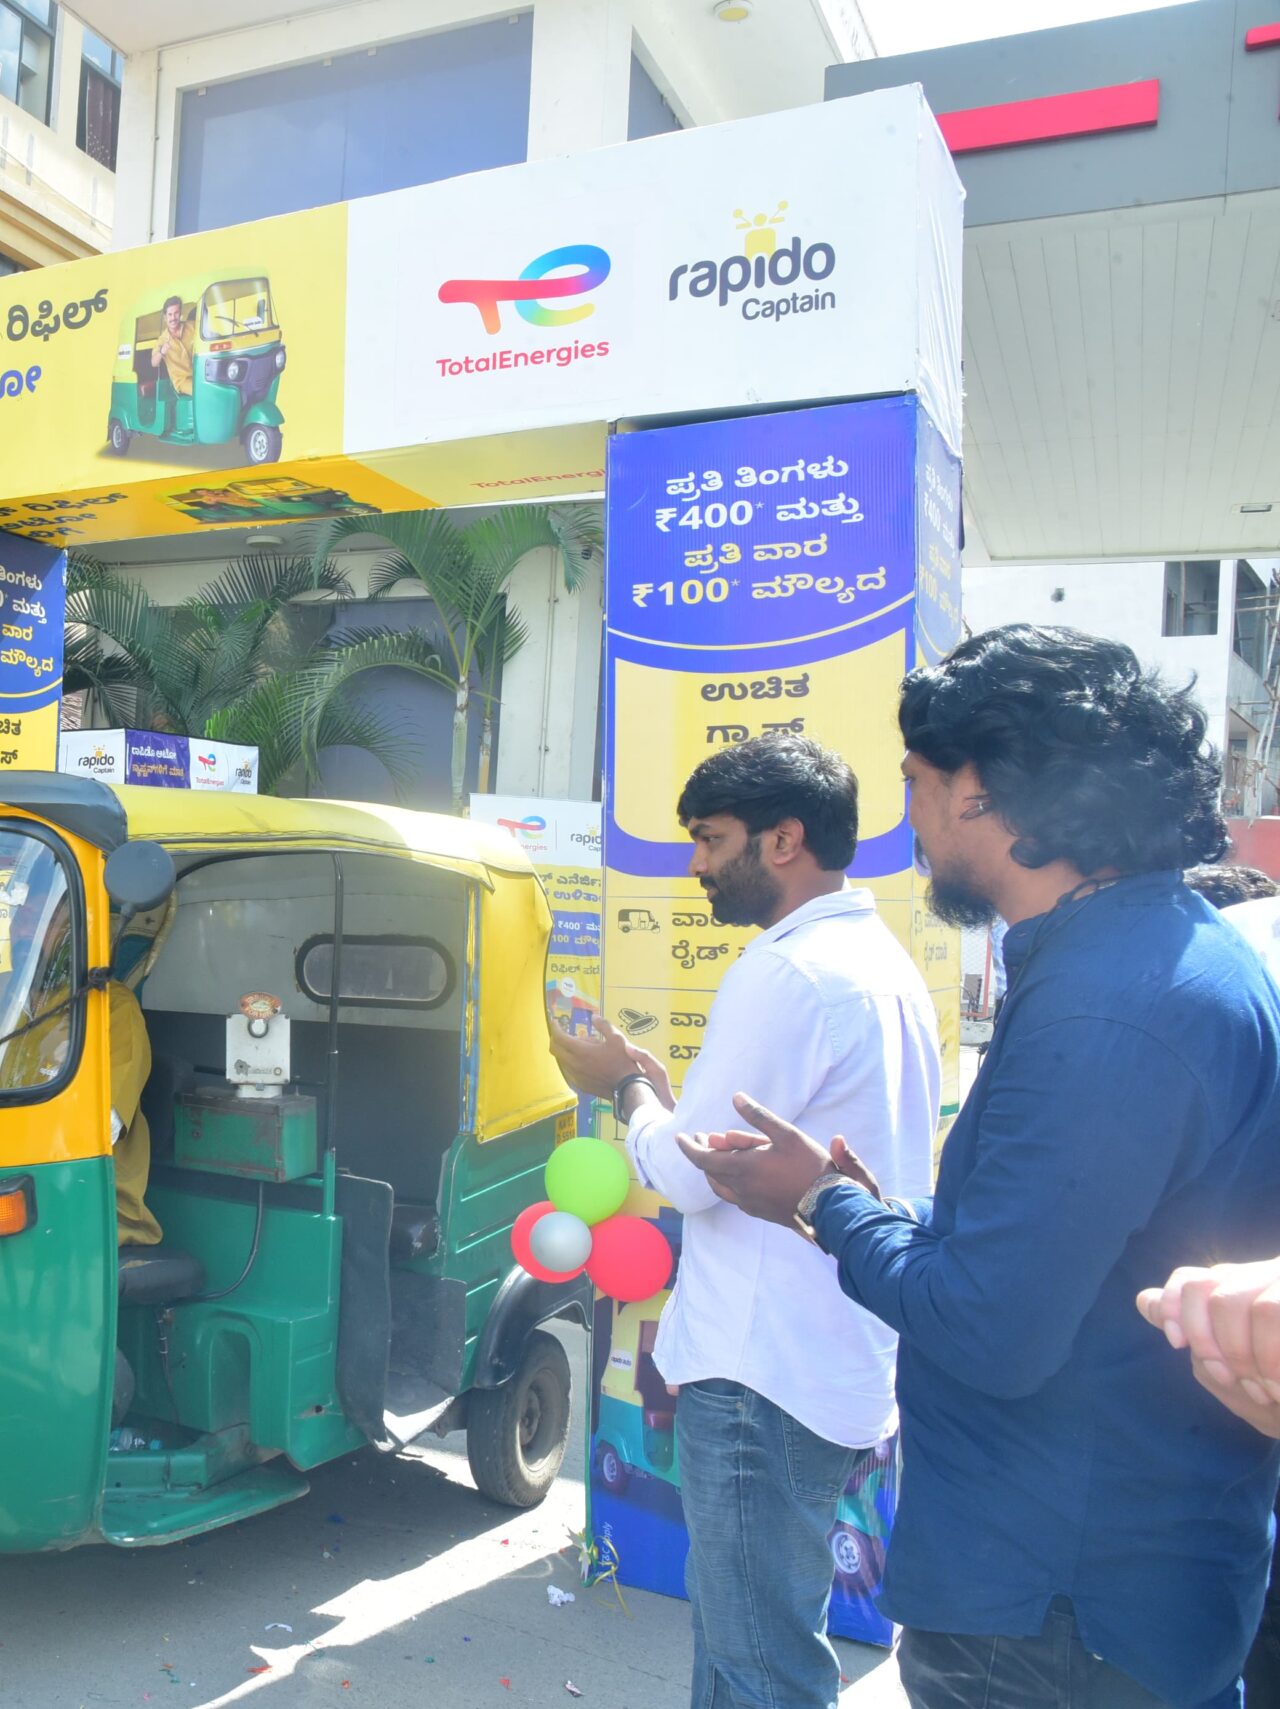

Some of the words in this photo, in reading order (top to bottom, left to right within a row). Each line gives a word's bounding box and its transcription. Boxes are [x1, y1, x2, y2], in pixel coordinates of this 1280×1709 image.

[668, 236, 836, 307] rapido
[6, 289, 109, 342] ರಿಫಿಲ್
[741, 288, 836, 322] Captain
[436, 339, 610, 377] TotalEnergies
[666, 470, 724, 502] ಪ್ರತಿ
[734, 455, 849, 488] ತಿಂಗಳು
[775, 492, 865, 524] ಮತ್ತು
[684, 542, 742, 574] ಪ್ರತಿ
[753, 533, 828, 562] ವಾರ
[12, 597, 48, 624] ಮತ್ತು
[2, 623, 33, 641] ವಾರ
[700, 672, 810, 702] ಉಚಿತ
[78, 754, 115, 768] rapido
[671, 940, 730, 969] ರೈಡ್
